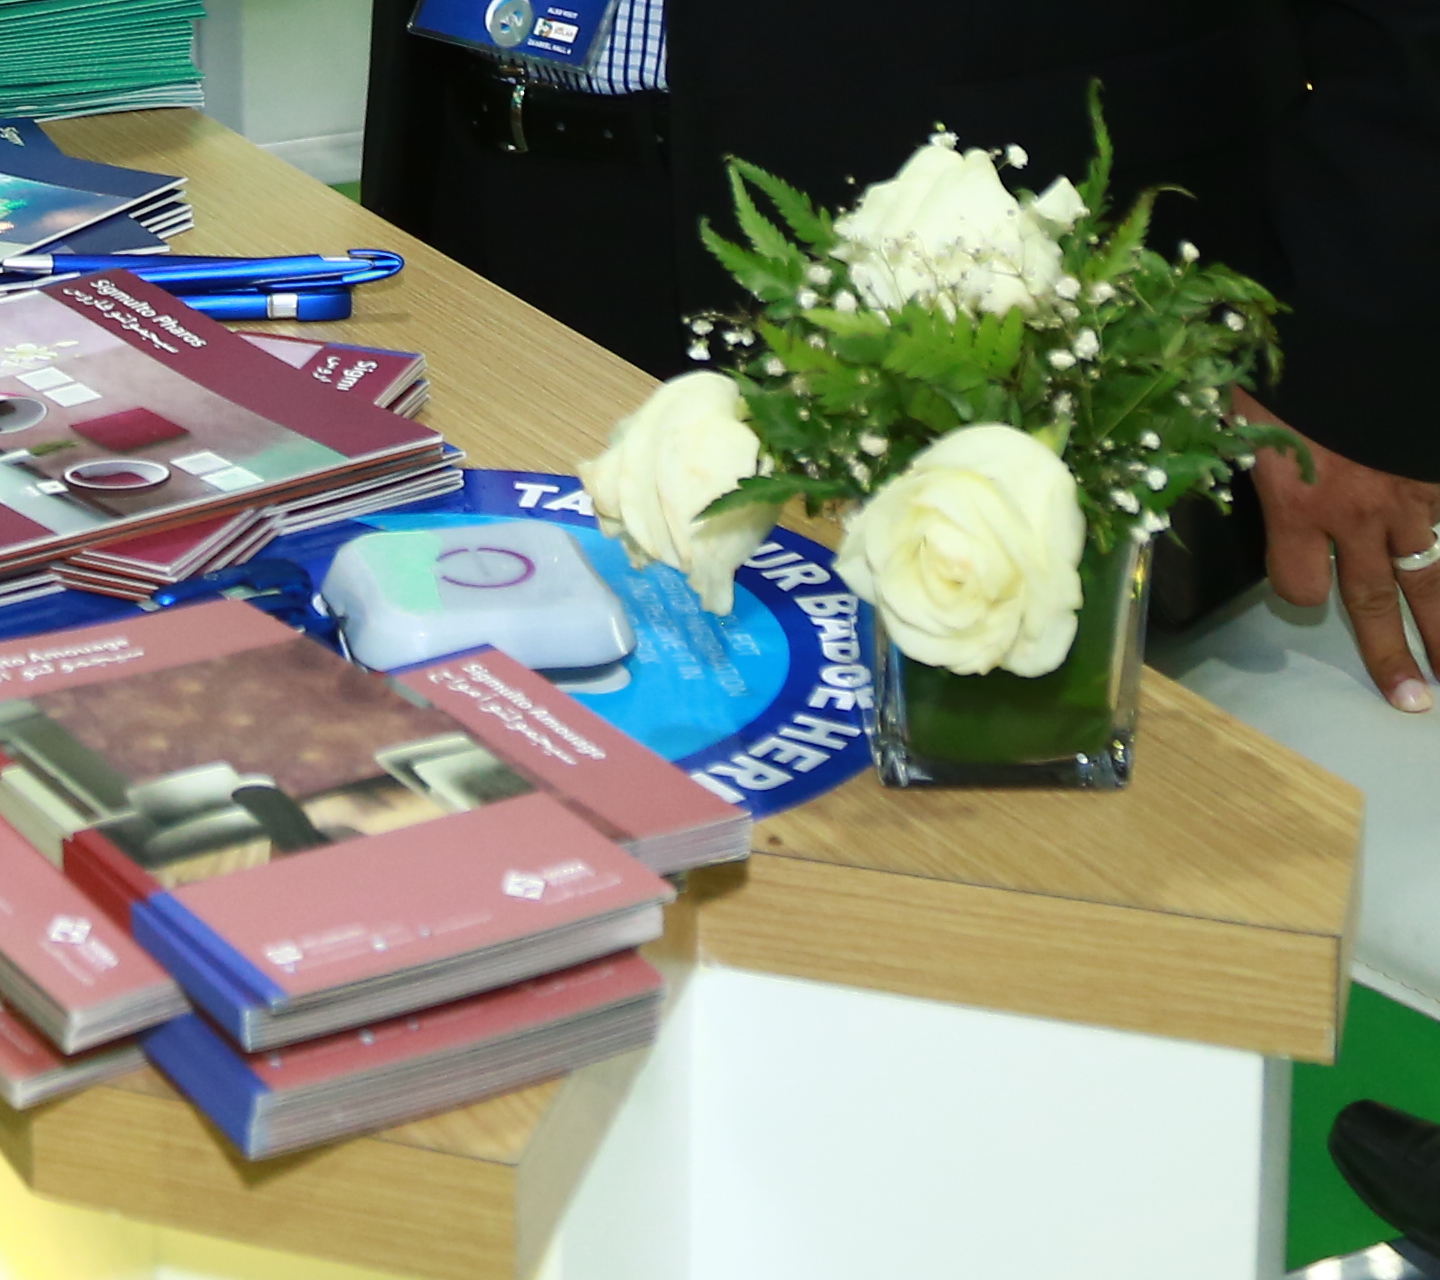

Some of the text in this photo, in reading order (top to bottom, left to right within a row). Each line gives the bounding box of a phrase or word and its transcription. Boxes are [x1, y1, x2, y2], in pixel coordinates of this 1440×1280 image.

[88, 277, 209, 350] Sigmulto Pharos
[515, 482, 595, 517] TA
[462, 661, 533, 710] Sigmulto
